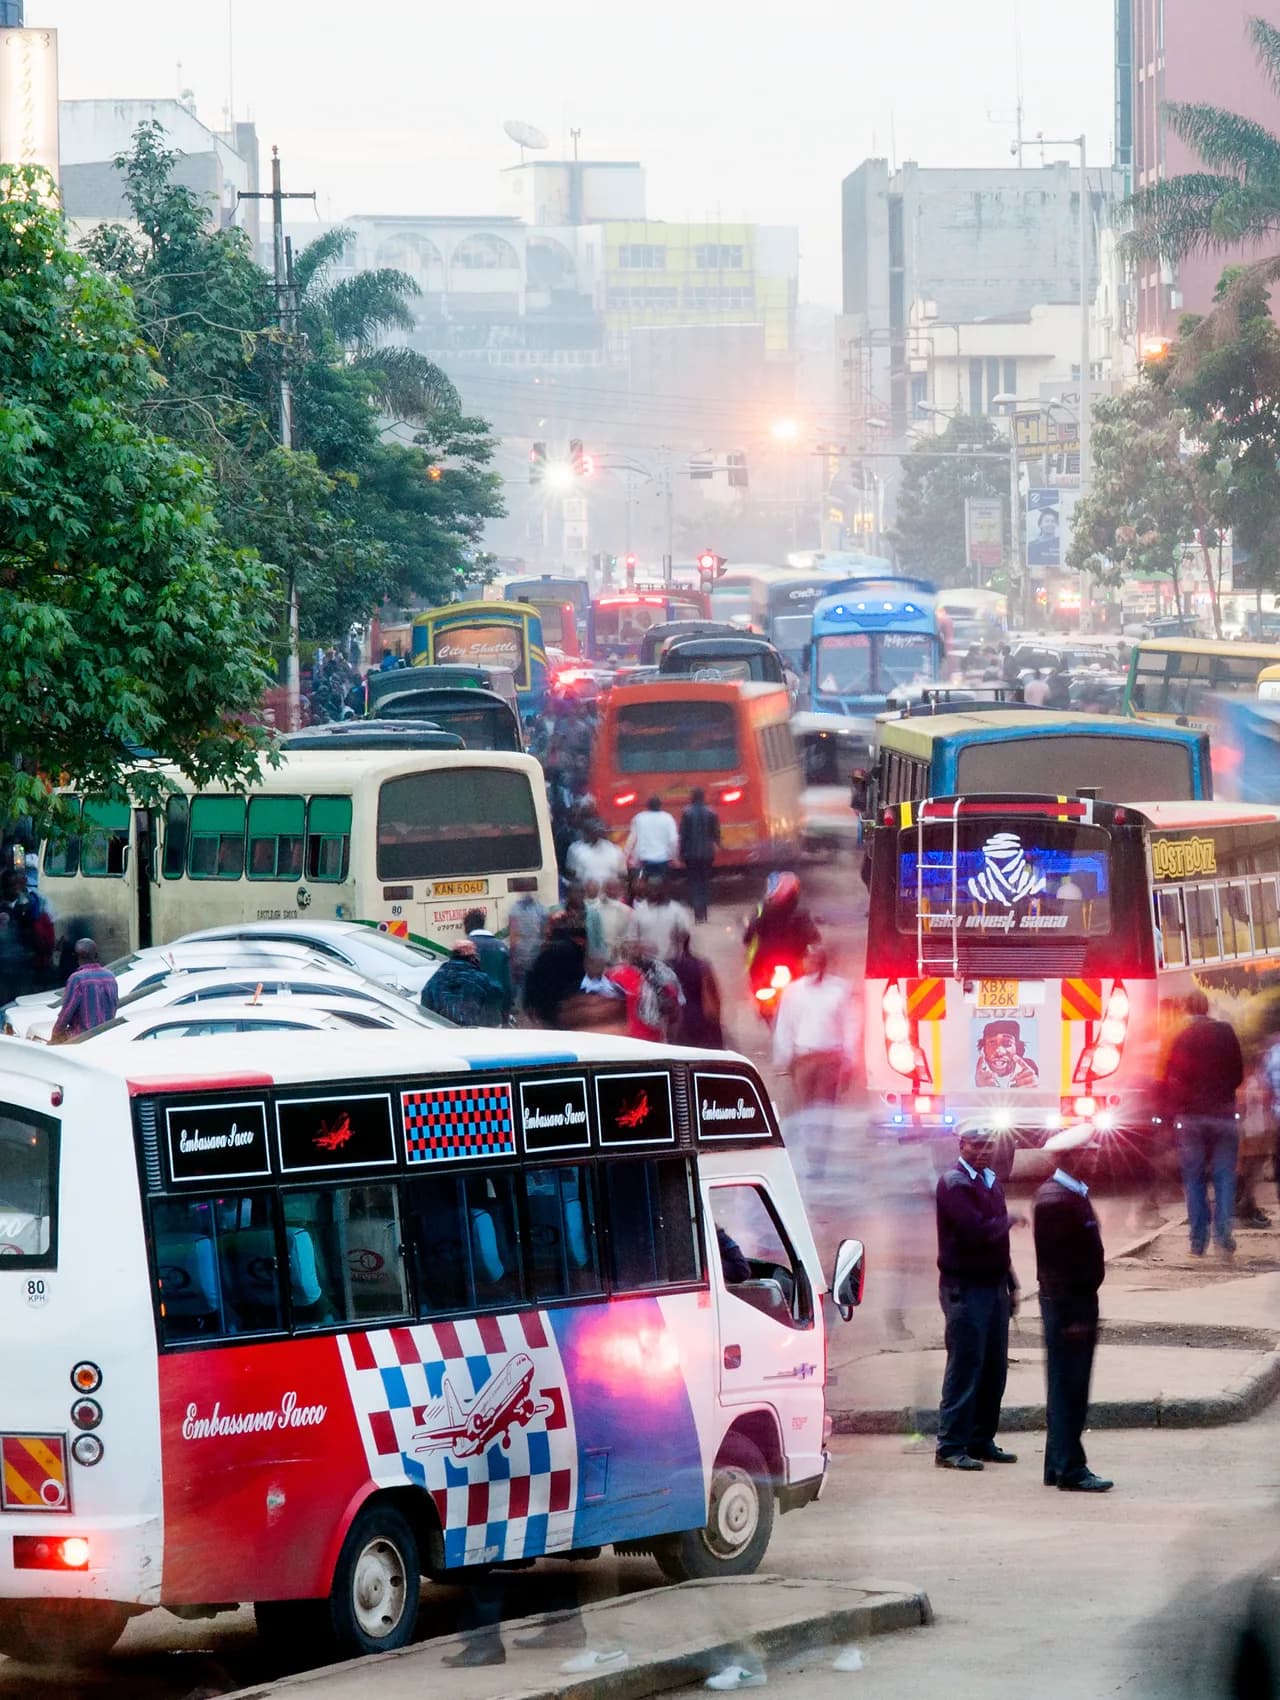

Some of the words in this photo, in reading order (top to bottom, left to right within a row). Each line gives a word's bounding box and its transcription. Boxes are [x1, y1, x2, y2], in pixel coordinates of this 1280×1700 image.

[438, 646, 465, 658] City
[470, 642, 518, 654] Shuttle
[1152, 838, 1184, 879] LOST
[1184, 835, 1217, 875] BOYZ
[434, 885, 454, 896] KAN
[391, 905, 402, 915] 80
[981, 981, 1007, 993] KBX
[982, 993, 1015, 1006] 126K
[972, 1007, 1036, 1019] ISUZU
[180, 1129, 227, 1153] Embassava
[227, 1122, 255, 1148] Sacco
[27, 1280, 45, 1295] 80
[28, 1294, 45, 1303] KPH
[182, 1401, 277, 1440] Embassava
[278, 1391, 328, 1429] Sacco
